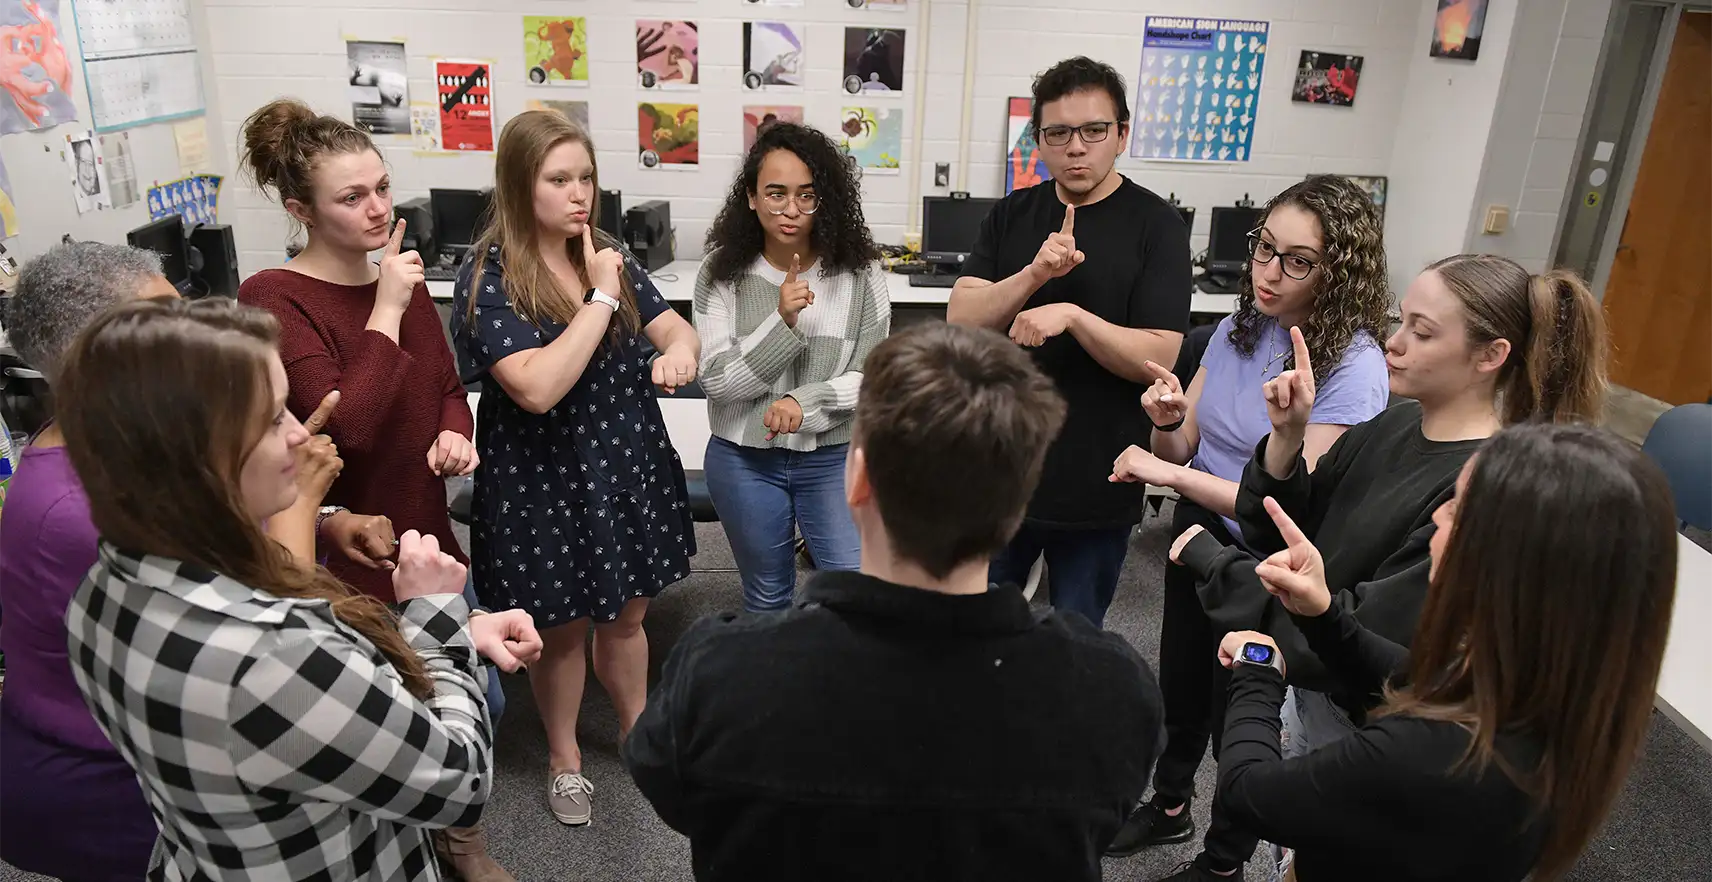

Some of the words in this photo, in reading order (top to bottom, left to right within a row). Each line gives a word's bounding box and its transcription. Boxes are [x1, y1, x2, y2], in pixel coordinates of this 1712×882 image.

[1147, 18, 1194, 29] AMERICAN
[1195, 19, 1219, 30] SIGN
[1220, 21, 1267, 33] LANGUAGE
[1147, 30, 1189, 41] Handshape
[1191, 31, 1212, 40] Chart
[454, 110, 467, 120] 12
